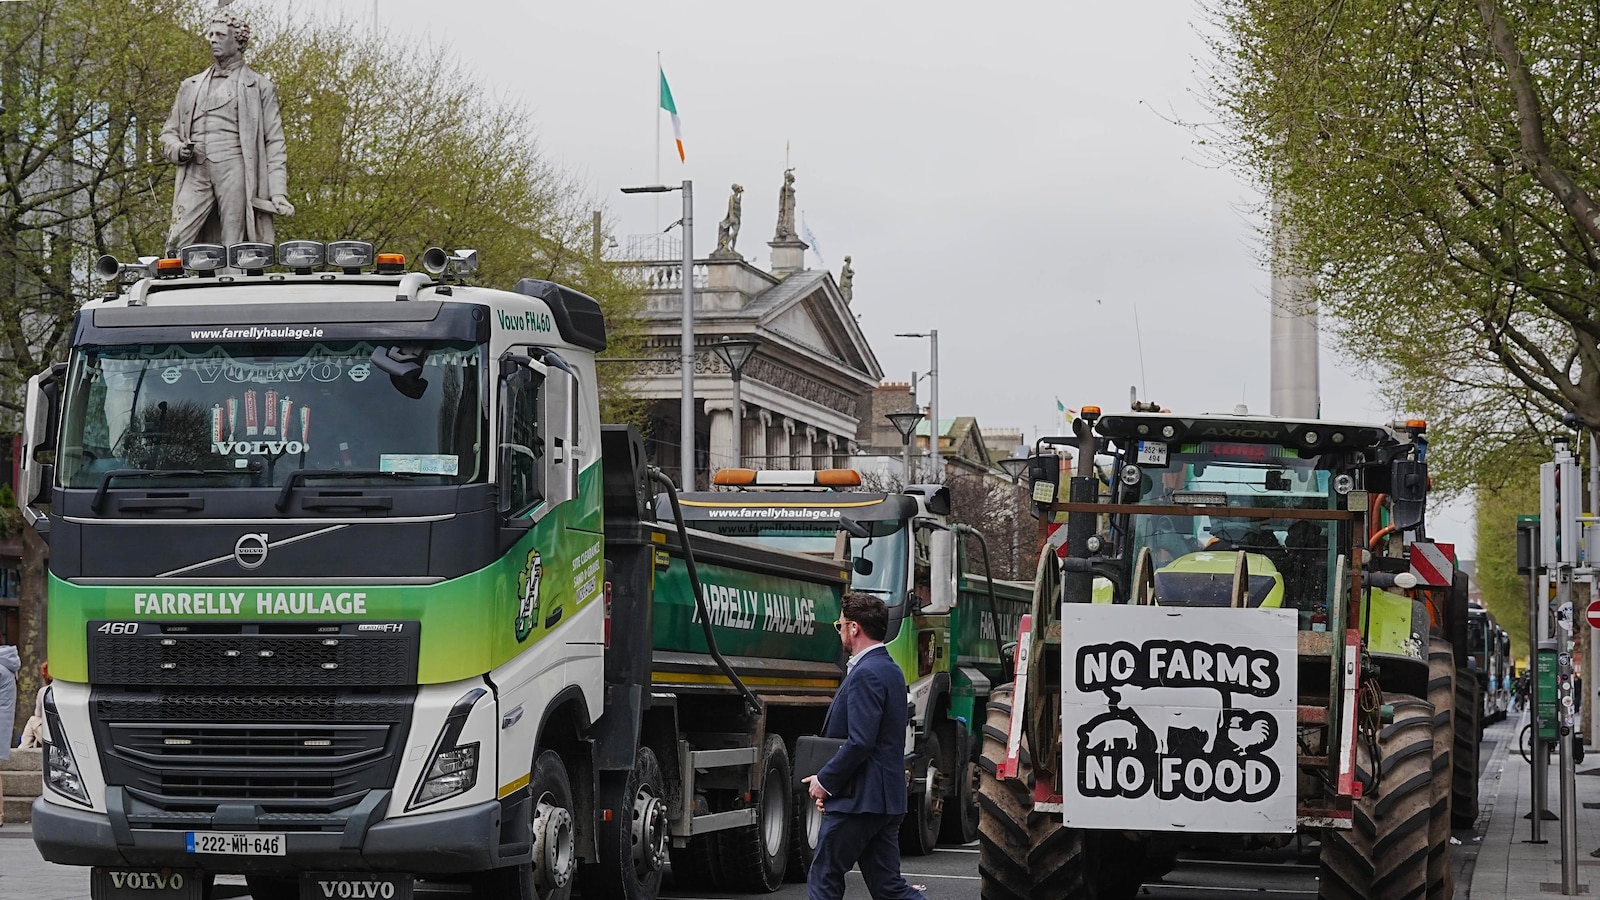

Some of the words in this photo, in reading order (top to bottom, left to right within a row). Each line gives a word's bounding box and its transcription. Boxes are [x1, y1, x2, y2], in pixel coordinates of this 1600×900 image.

[525, 311, 551, 333] FH460
[191, 327, 324, 340] www.farrellyhaulage.ie
[194, 362, 342, 383] VOLVO
[1202, 427, 1279, 439] AXION
[214, 441, 303, 455] VOLVO
[709, 508, 841, 519] www.farrellyhaulage.ie
[134, 592, 245, 614] FARRELLY
[256, 592, 367, 614] HAULAGE
[762, 593, 816, 635] HAULAGE
[97, 622, 139, 634] 460
[384, 624, 403, 632] FH
[1083, 649, 1135, 685] NO
[1149, 648, 1271, 690] FARMS
[1085, 755, 1145, 792] NO
[1162, 757, 1272, 796] FOOD
[202, 836, 279, 853] 222-MH-646
[109, 871, 183, 890] VOLVO
[318, 880, 395, 899] VOLVO
